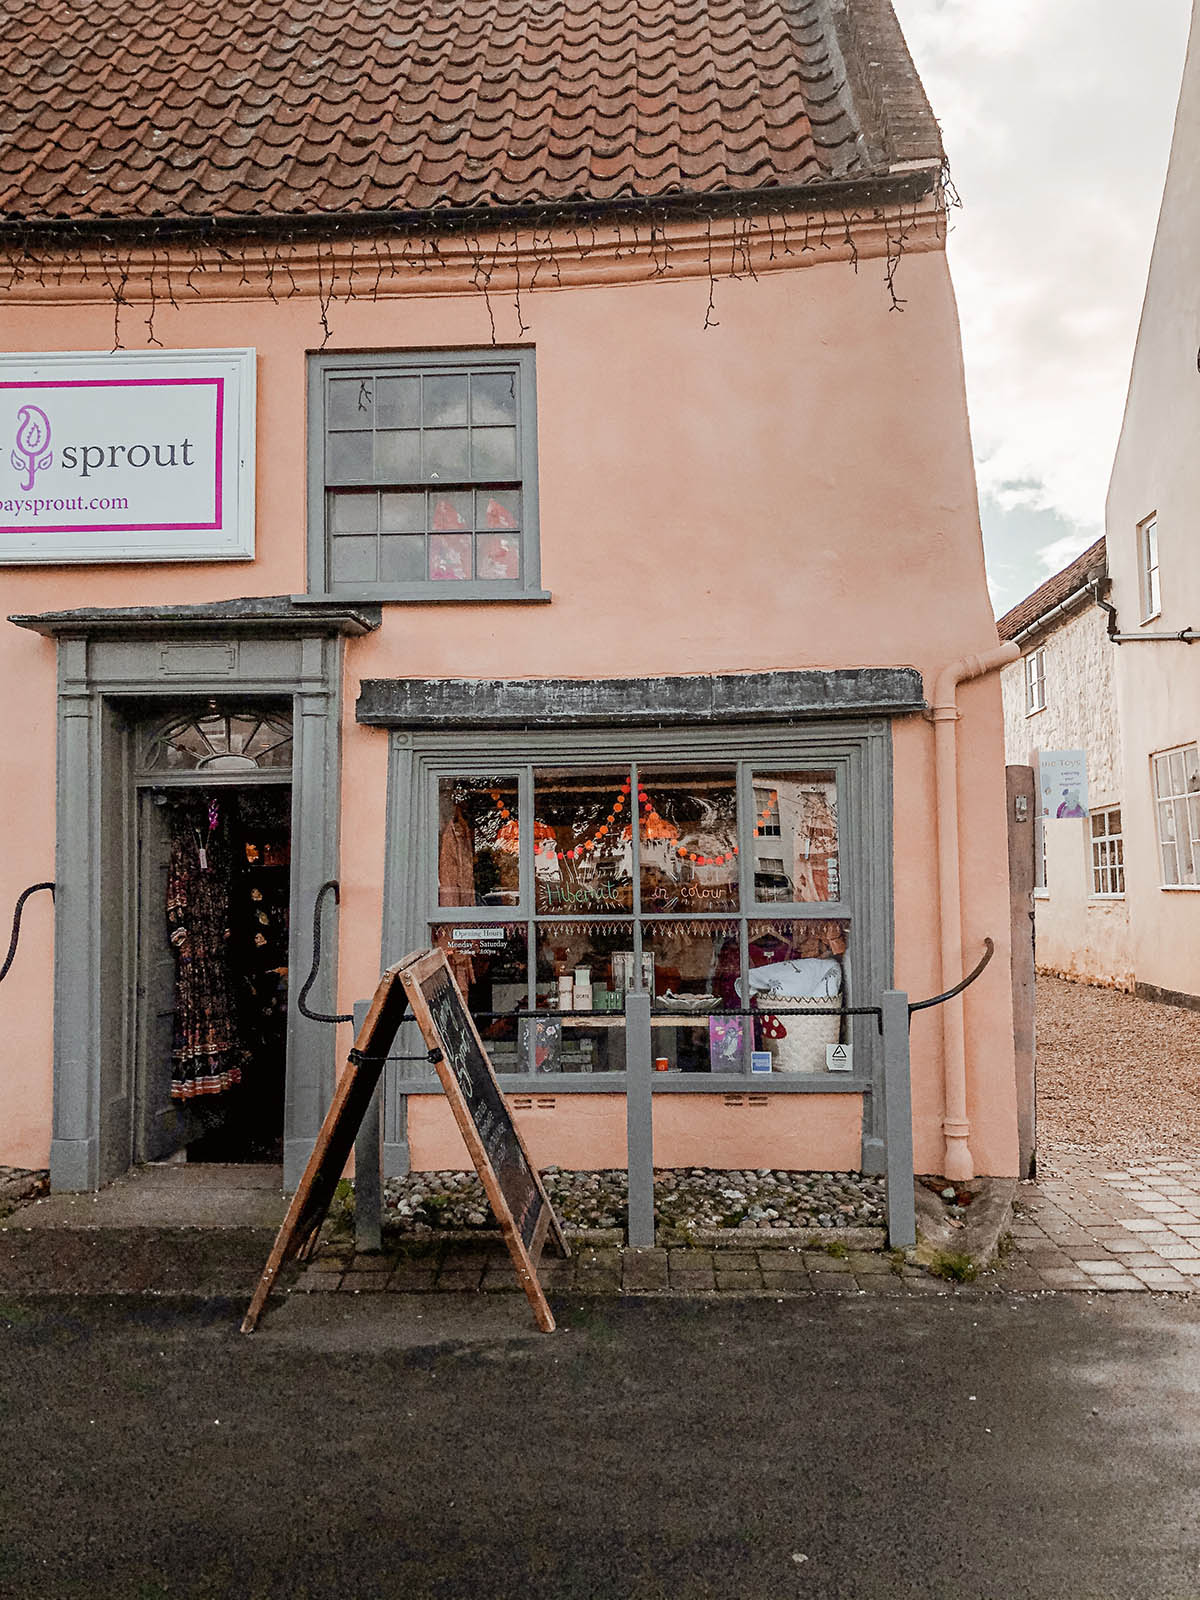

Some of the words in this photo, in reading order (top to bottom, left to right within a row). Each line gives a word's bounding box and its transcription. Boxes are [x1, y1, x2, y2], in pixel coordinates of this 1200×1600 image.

[61, 438, 195, 478] sprout
[547, 880, 623, 905] Hibernate
[651, 886, 669, 900] in
[681, 883, 726, 899] colour
[455, 930, 482, 938] Opening
[447, 941, 473, 949] Monday
[479, 940, 508, 949] Saturday
